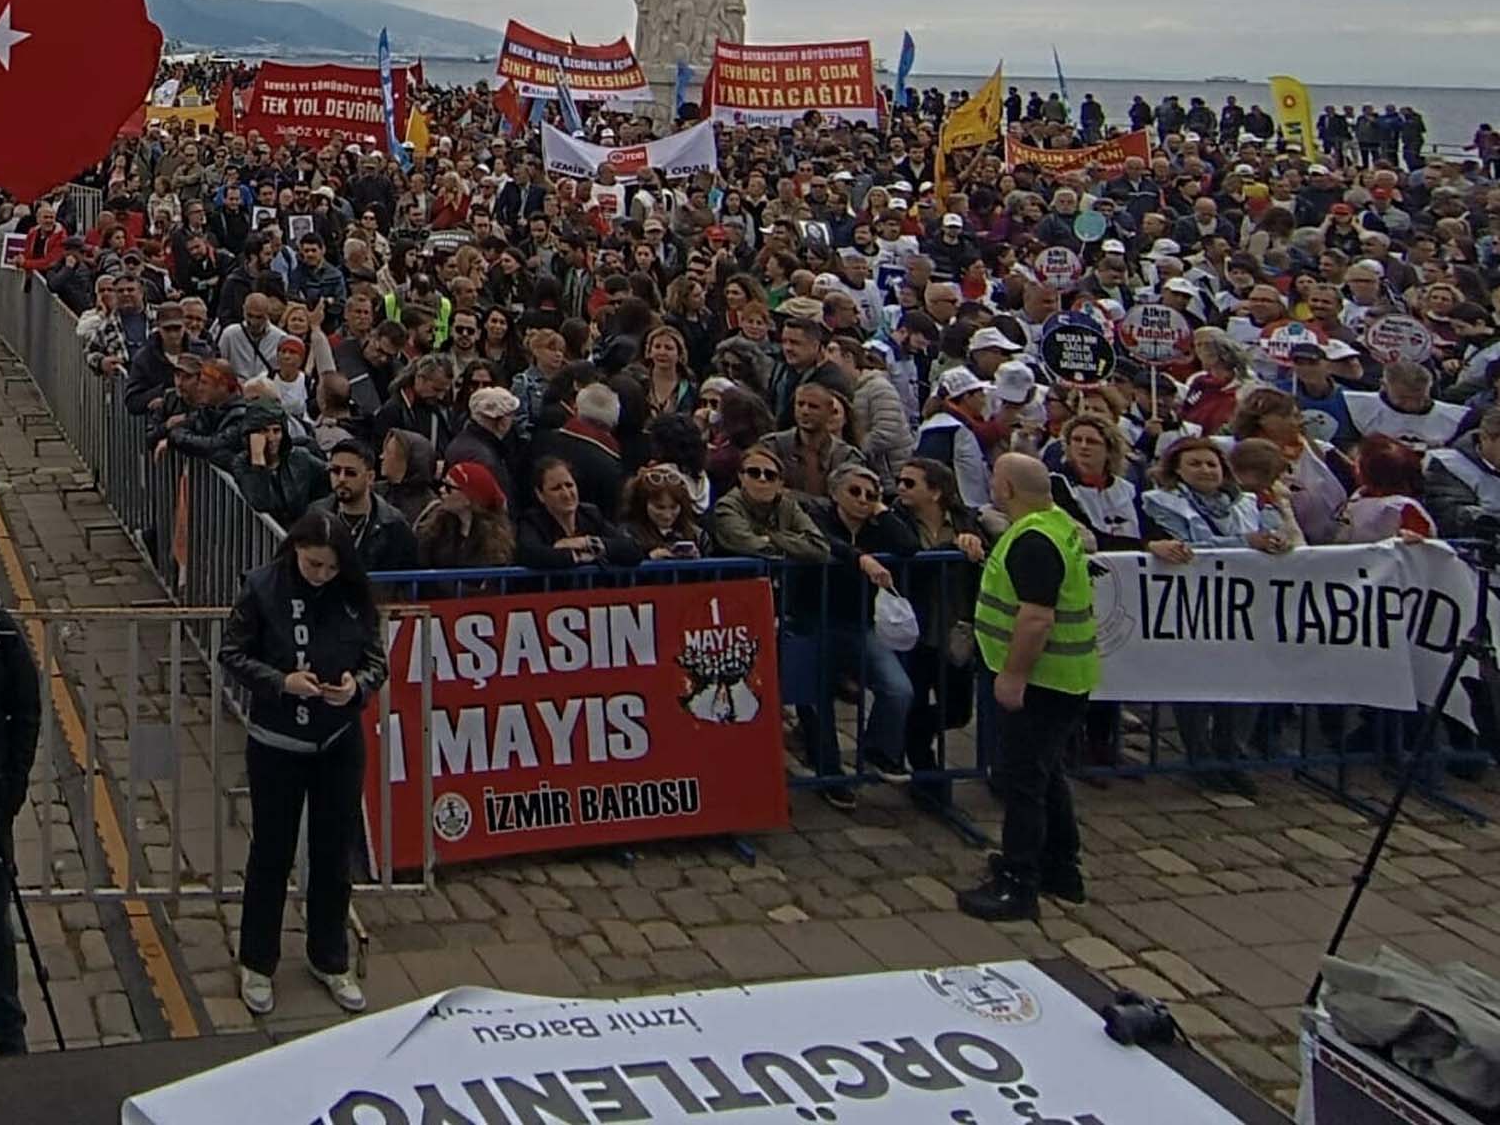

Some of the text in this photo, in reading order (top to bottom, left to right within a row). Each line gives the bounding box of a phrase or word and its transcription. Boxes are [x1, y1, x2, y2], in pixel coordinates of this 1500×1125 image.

[501, 57, 643, 88] SINIF MÜADELESİNE!
[719, 63, 860, 83] DEVRİMCİ BİR ODAK
[718, 82, 863, 107] YARATACAĞIZ!
[261, 96, 385, 124] TEK YOL DEVRİM
[316, 127, 331, 139] VE
[1142, 306, 1171, 319] Alkış
[1136, 326, 1175, 341] Adalet
[708, 597, 722, 627] 1
[1139, 556, 1255, 642] İZMİR
[1270, 568, 1404, 649] TABİP
[684, 624, 750, 654] MAYIS
[291, 598, 311, 726] POLS
[431, 693, 650, 777] MAYIS
[483, 777, 700, 835] İZMİR BAROSU
[472, 1017, 601, 1046] Barosu
[608, 1005, 704, 1034] İzmir
